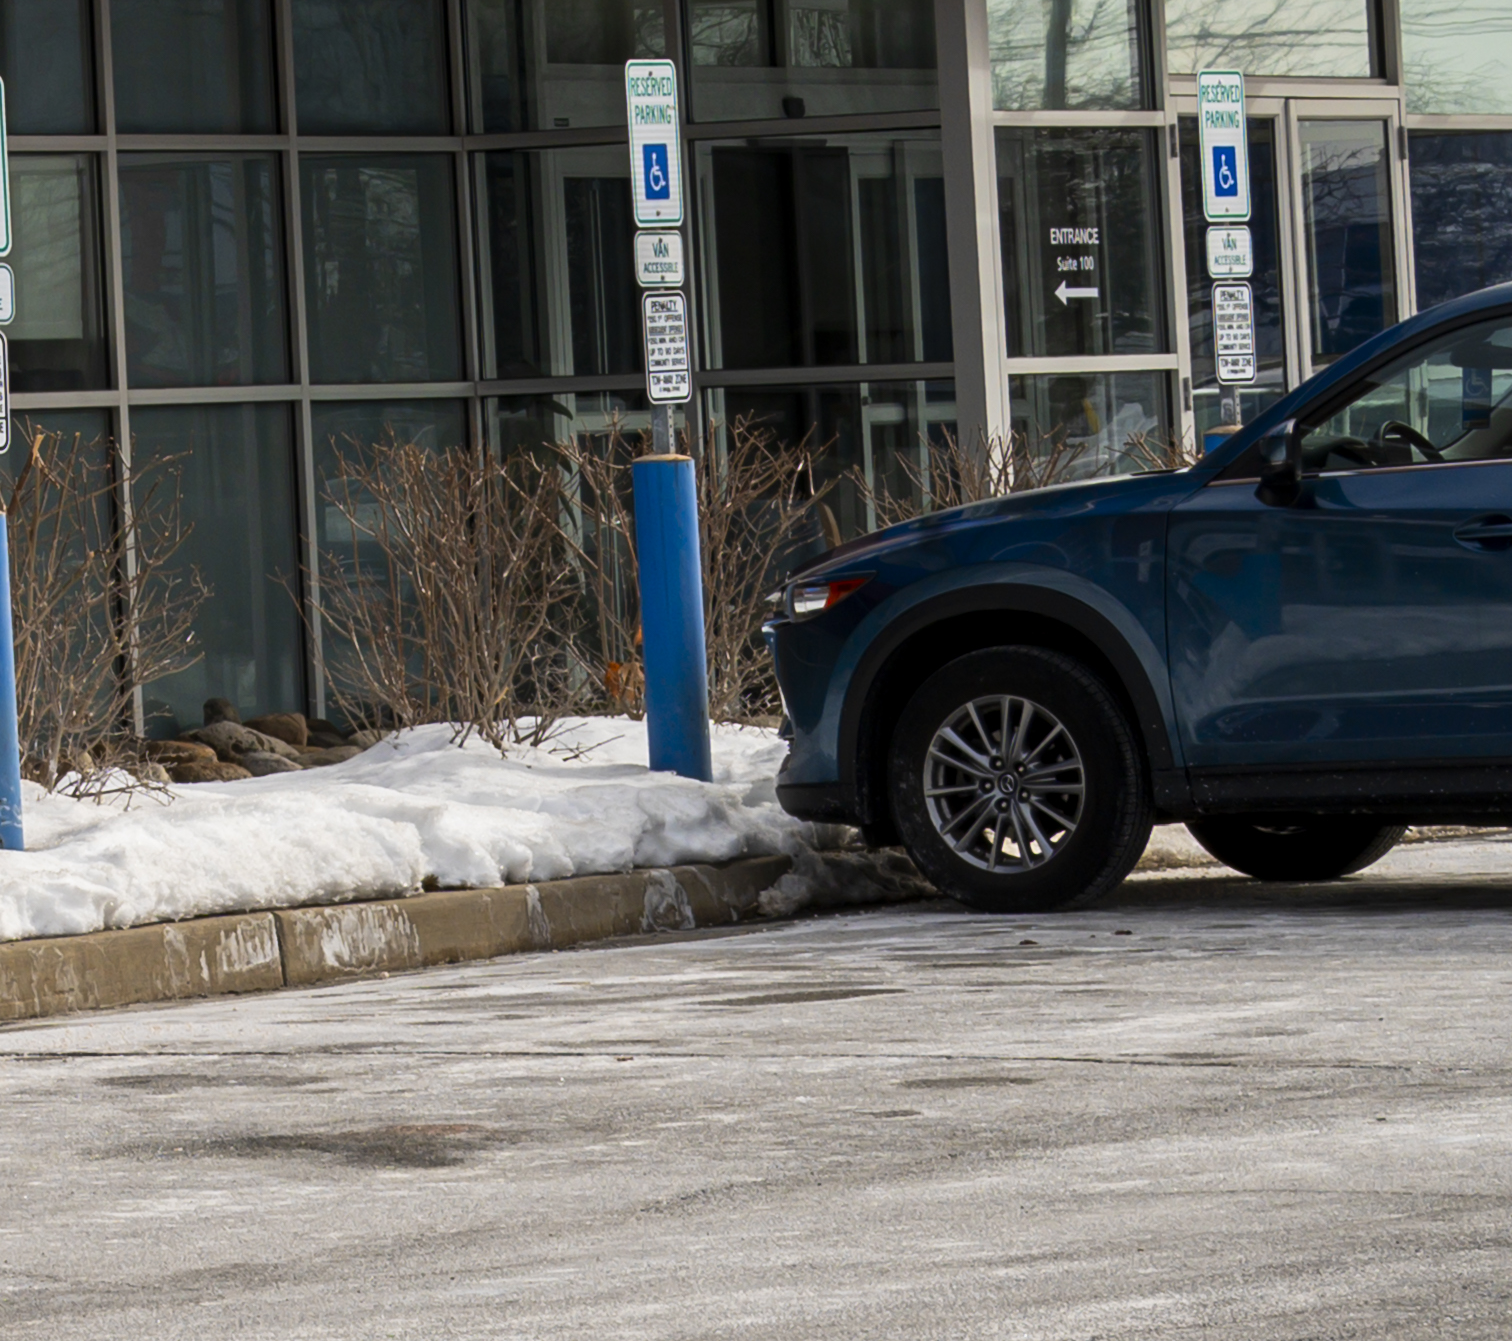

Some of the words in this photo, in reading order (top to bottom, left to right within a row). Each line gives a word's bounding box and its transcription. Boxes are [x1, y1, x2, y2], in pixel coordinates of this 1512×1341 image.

[630, 77, 673, 97] RESERVED
[1201, 85, 1240, 103] RESERVED
[635, 104, 671, 124] PARKING
[1205, 110, 1239, 128] PARKING
[1050, 227, 1099, 245] ENTRANCE
[1222, 237, 1237, 251] VAN
[652, 242, 669, 258] VAN
[643, 262, 679, 274] ACCESSIBLE
[1057, 256, 1077, 271] Suite
[1079, 256, 1094, 270] 100
